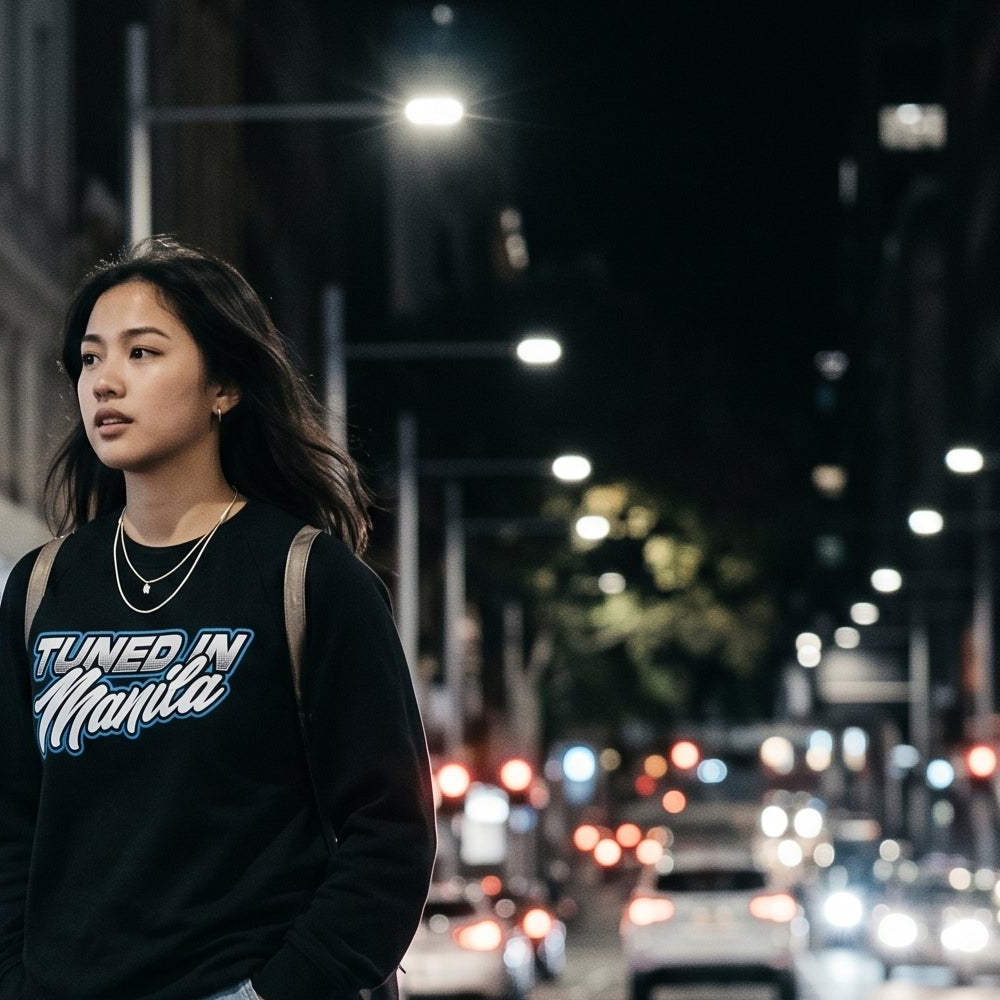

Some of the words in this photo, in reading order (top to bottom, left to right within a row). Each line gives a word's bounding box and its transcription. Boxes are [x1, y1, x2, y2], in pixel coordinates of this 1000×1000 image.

[36, 633, 183, 676] TUNED
[187, 632, 248, 672] IN
[35, 654, 225, 753] Manila
